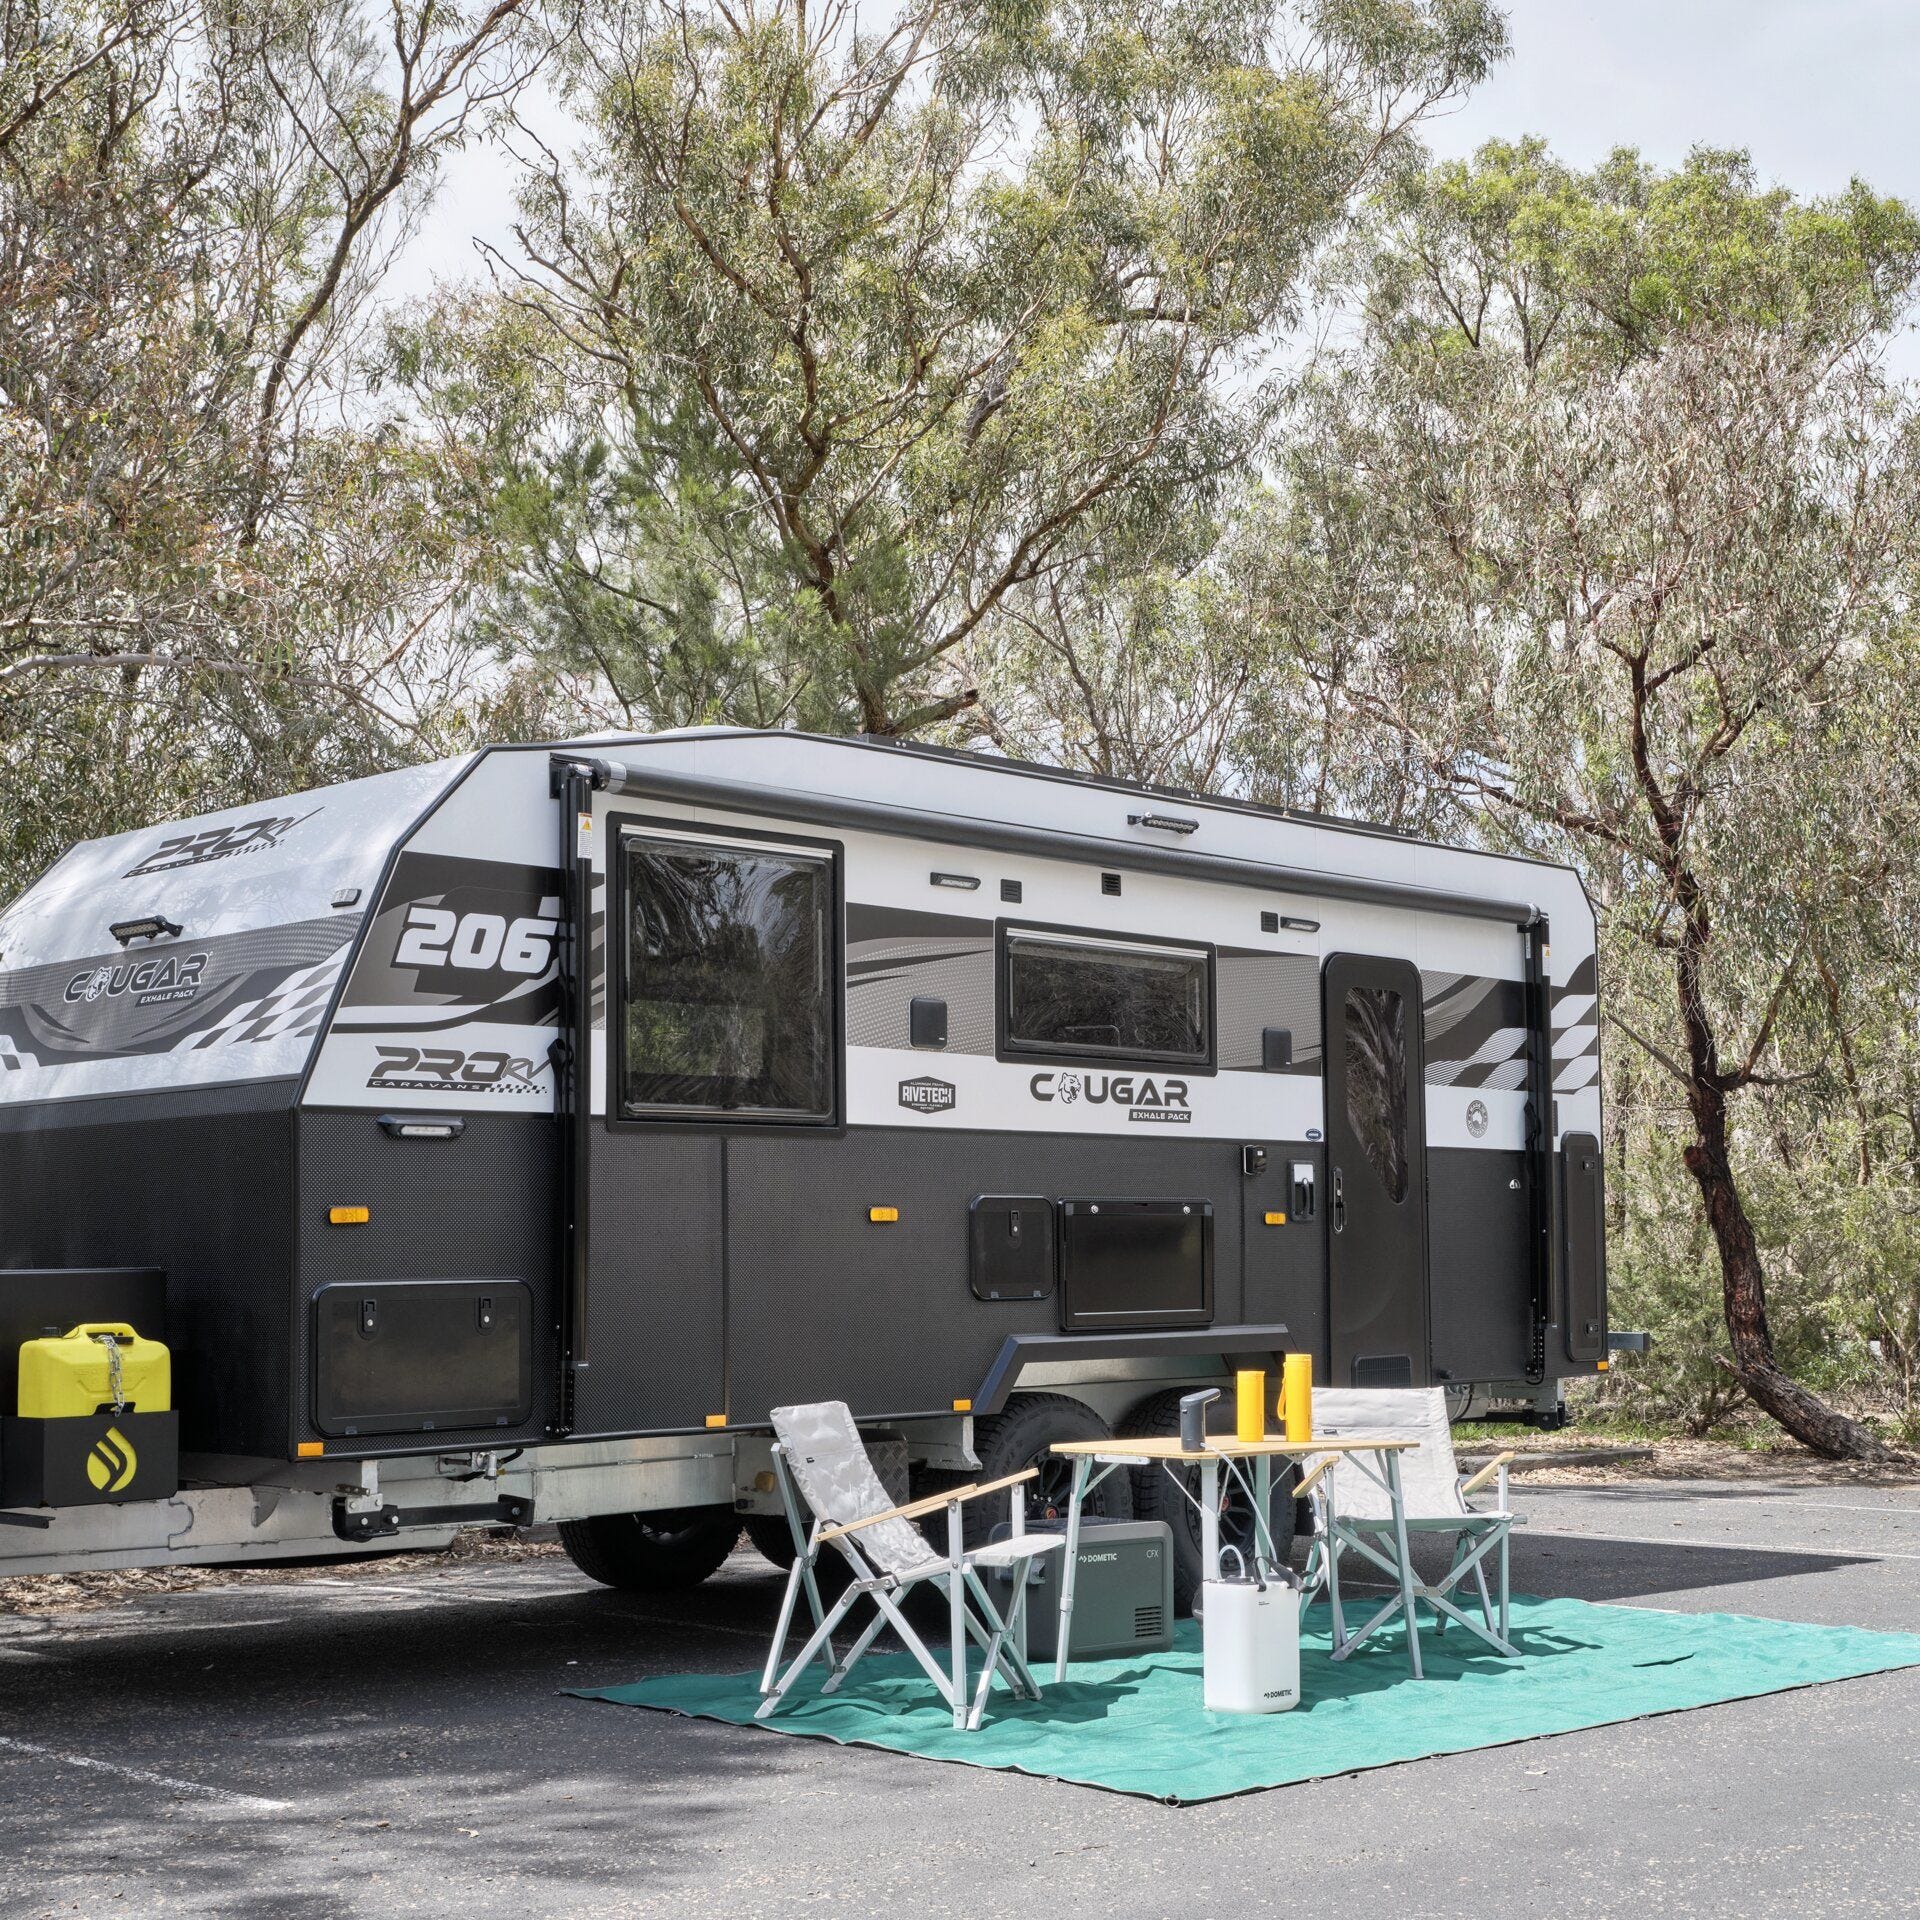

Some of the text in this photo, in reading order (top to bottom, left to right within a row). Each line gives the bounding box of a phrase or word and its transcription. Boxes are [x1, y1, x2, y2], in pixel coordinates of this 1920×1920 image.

[128, 854, 221, 876] CARAVANS
[395, 907, 558, 974] 206
[140, 989, 195, 1004] EXHALE PACK
[372, 1080, 482, 1090] CARAVANS
[902, 1086, 953, 1103] RIVETECH
[1132, 1111, 1189, 1121] EXHALE PACK
[1088, 1552, 1118, 1562] DOMETIC
[1146, 1549, 1159, 1558] CFX
[1270, 1689, 1292, 1698] DOMETIC
